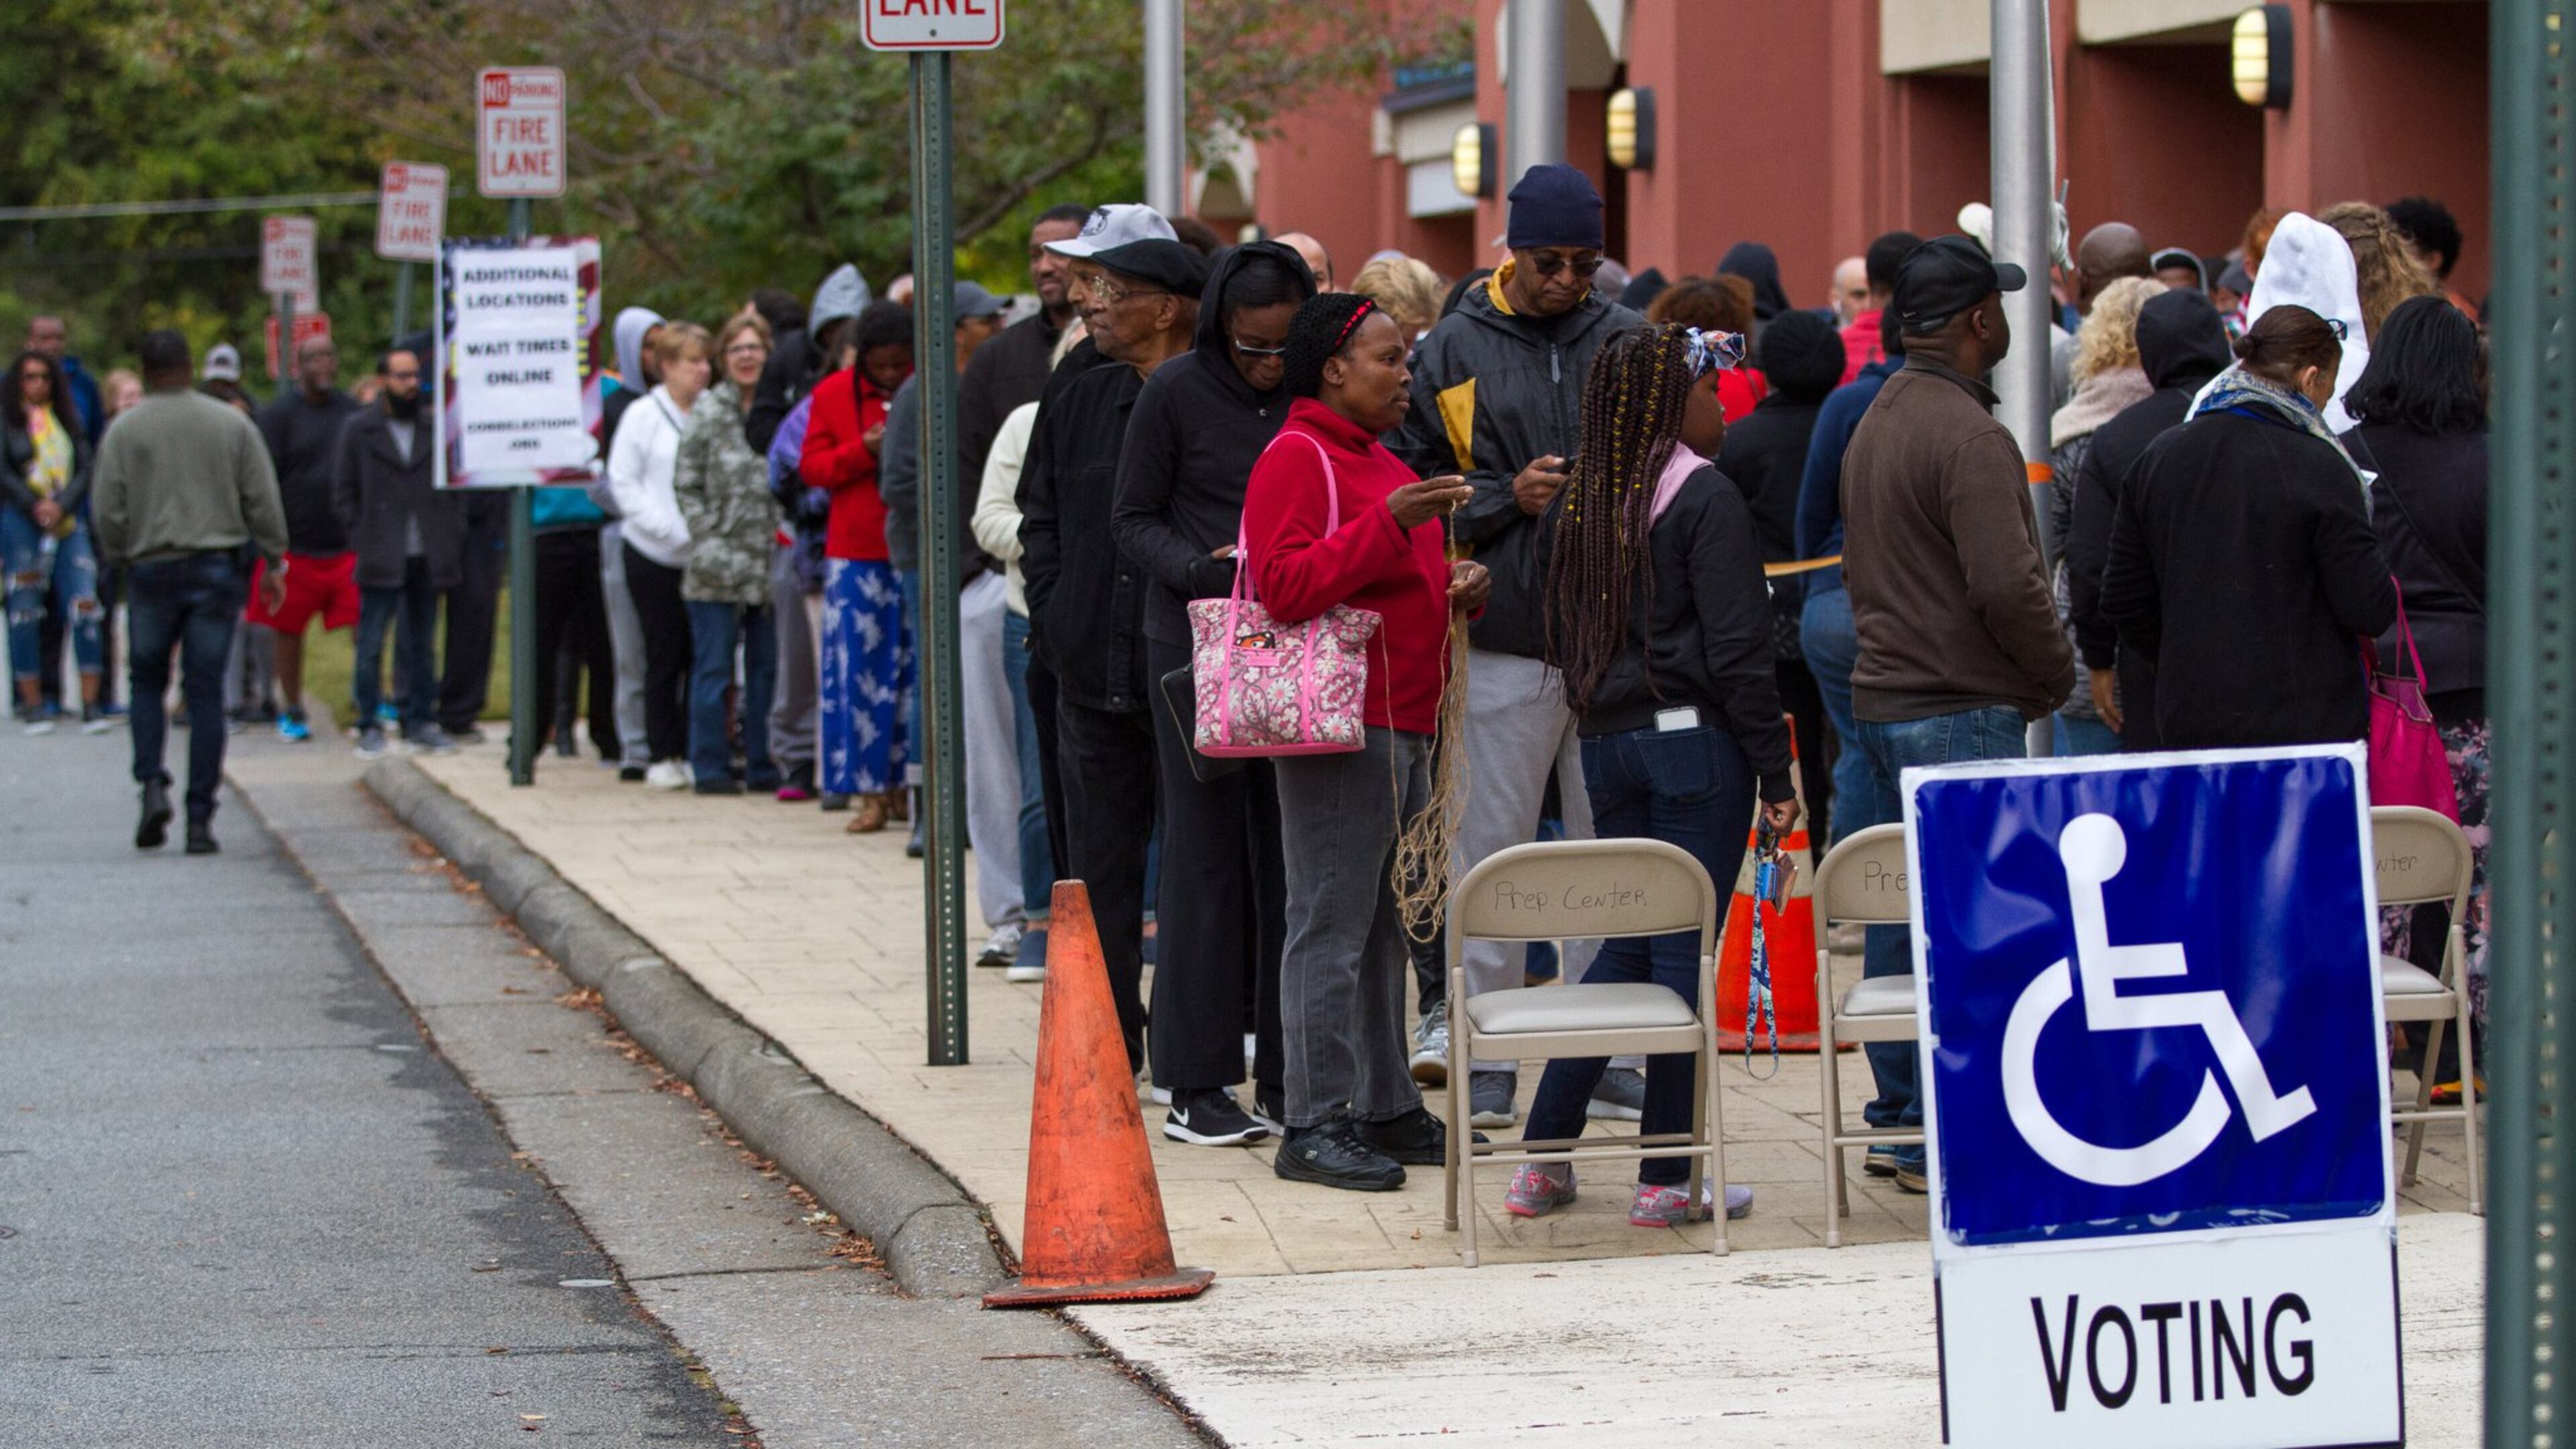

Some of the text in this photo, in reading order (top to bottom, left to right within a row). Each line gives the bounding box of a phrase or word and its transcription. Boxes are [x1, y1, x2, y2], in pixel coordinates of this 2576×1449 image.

[495, 117, 549, 144] FIRE
[492, 150, 552, 177] LANE
[464, 267, 569, 283] ADDITIONAL
[467, 293, 568, 309] LOCATIONS
[467, 339, 570, 356] WAIT TIMES
[486, 370, 552, 385] ONLINE
[1864, 861, 1909, 892] Pre
[1495, 881, 1548, 913] Prep
[2031, 1292, 2315, 1413] VOTING
